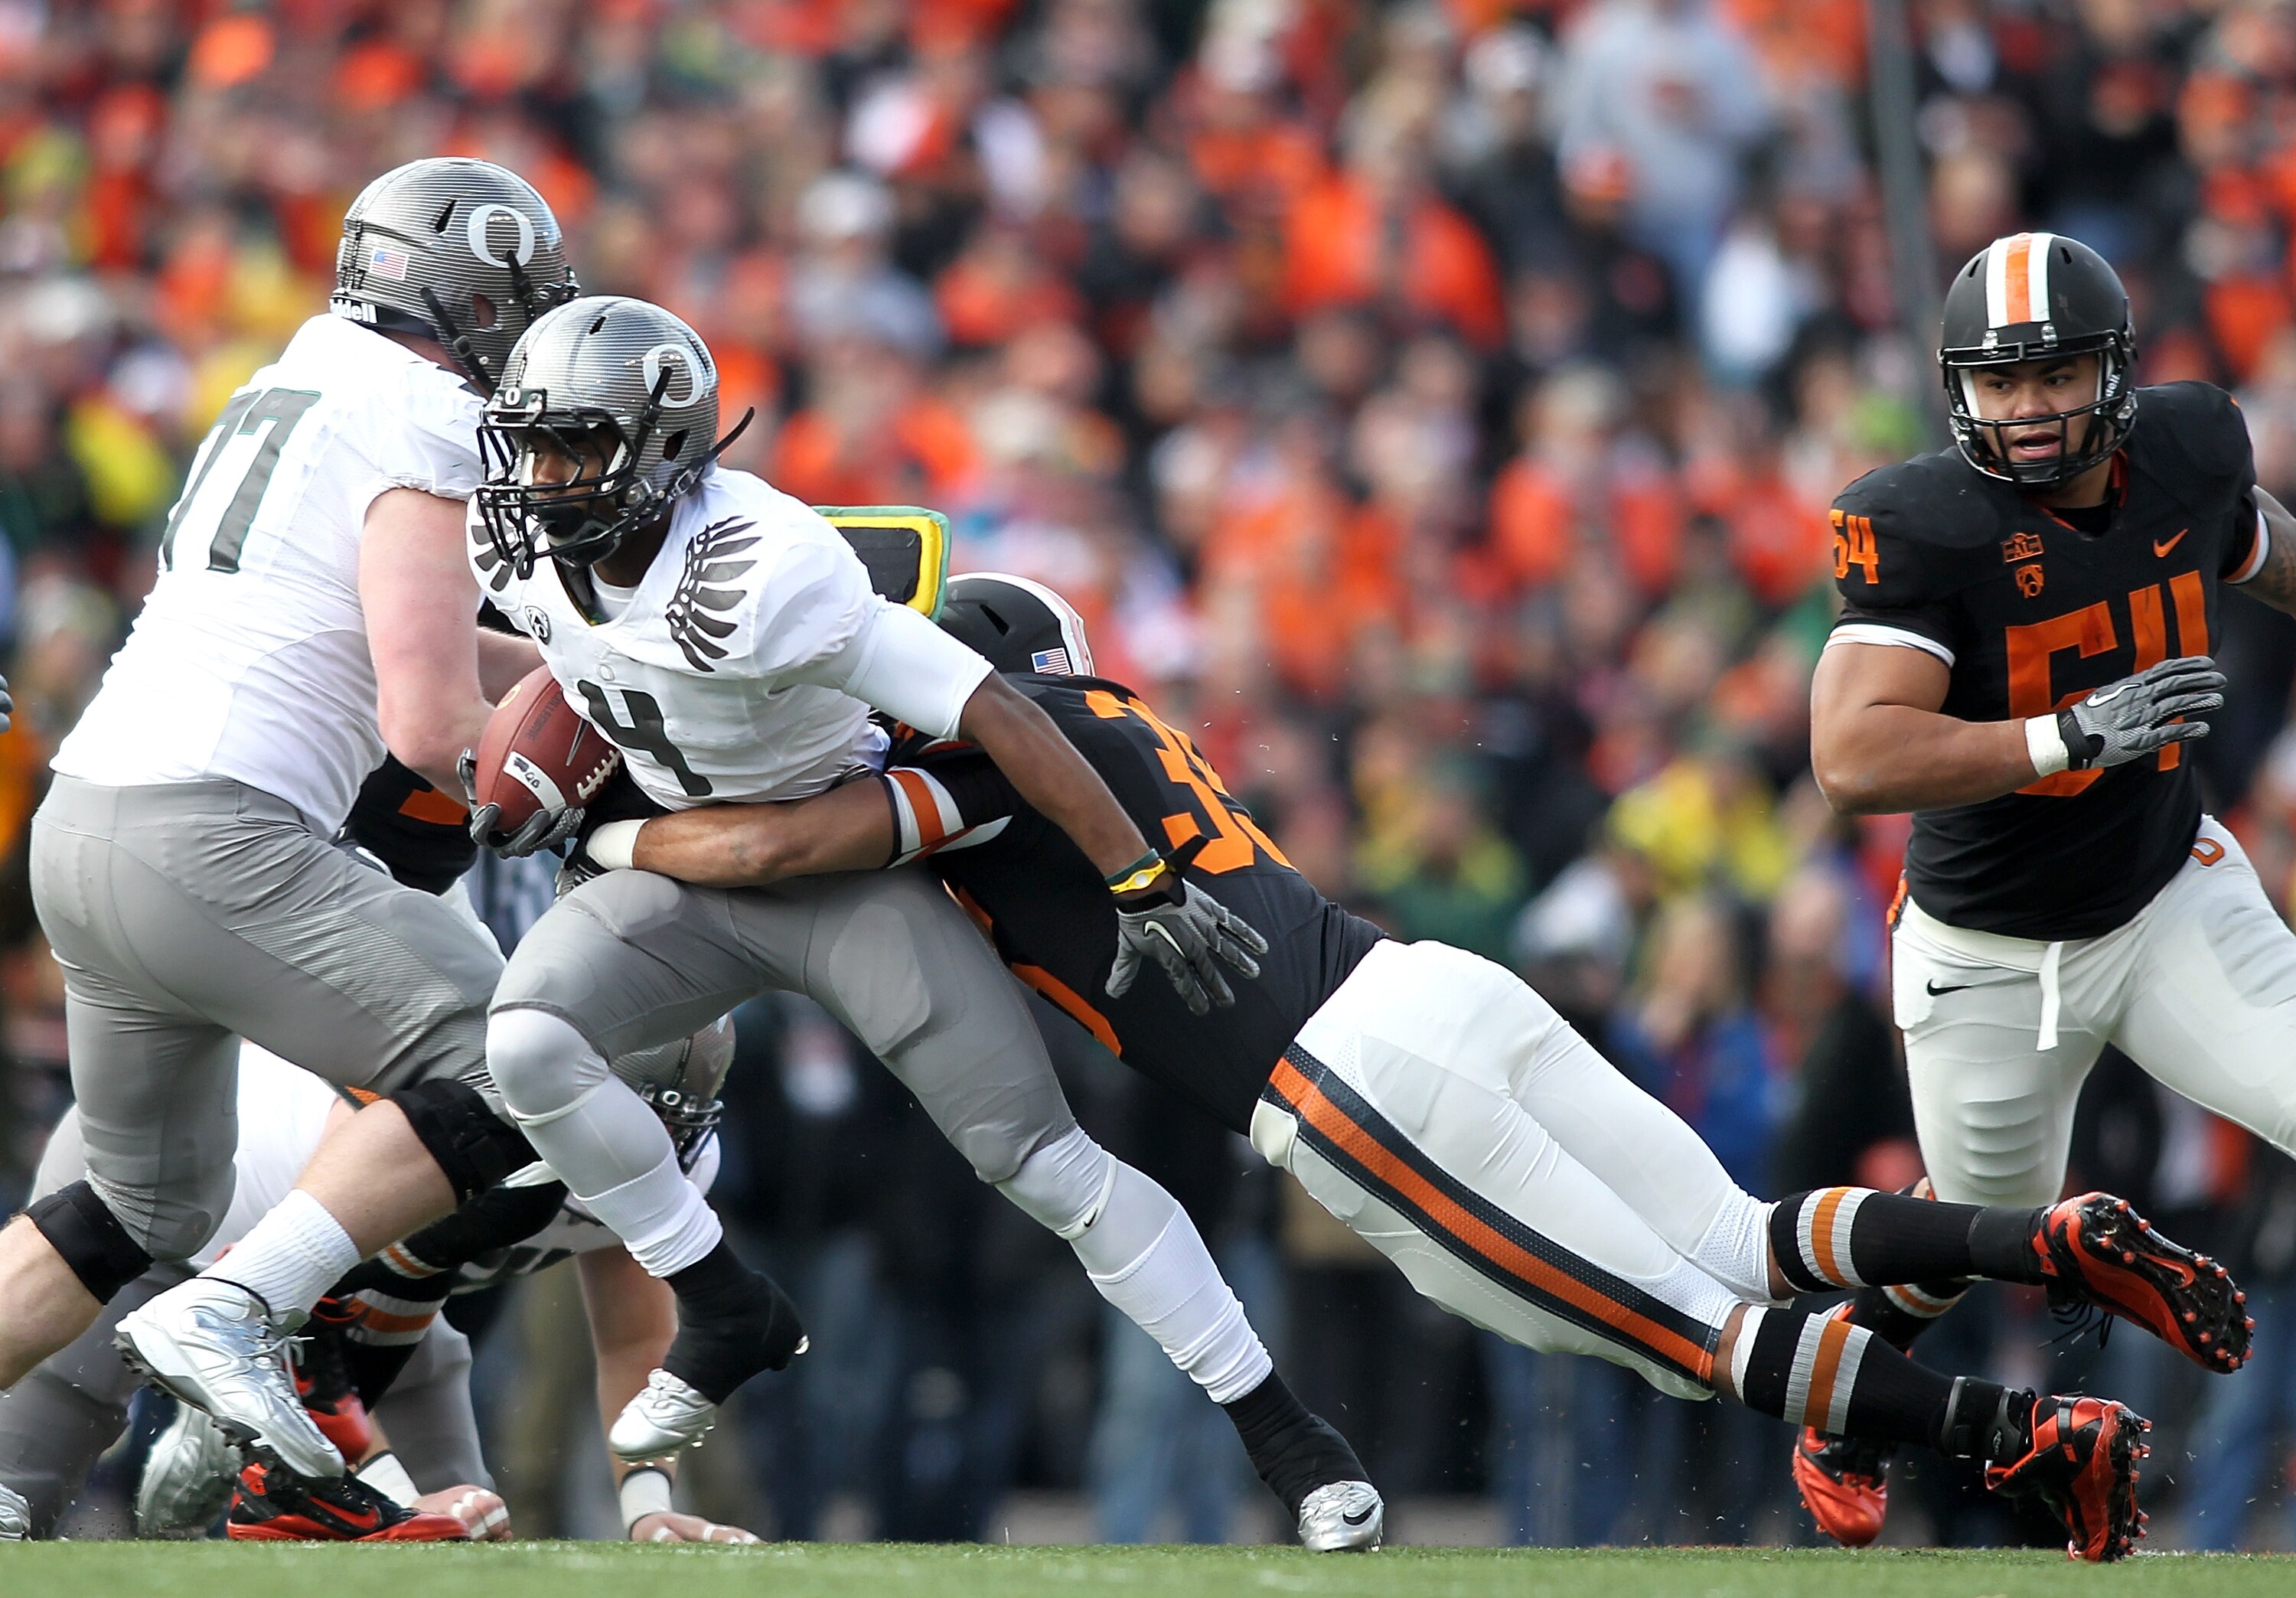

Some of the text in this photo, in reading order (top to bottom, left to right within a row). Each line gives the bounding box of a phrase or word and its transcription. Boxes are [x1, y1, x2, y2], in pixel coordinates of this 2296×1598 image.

[163, 387, 322, 575] 77
[1828, 509, 1880, 584] 54
[577, 680, 713, 797] 4
[2005, 570, 2210, 797] 54
